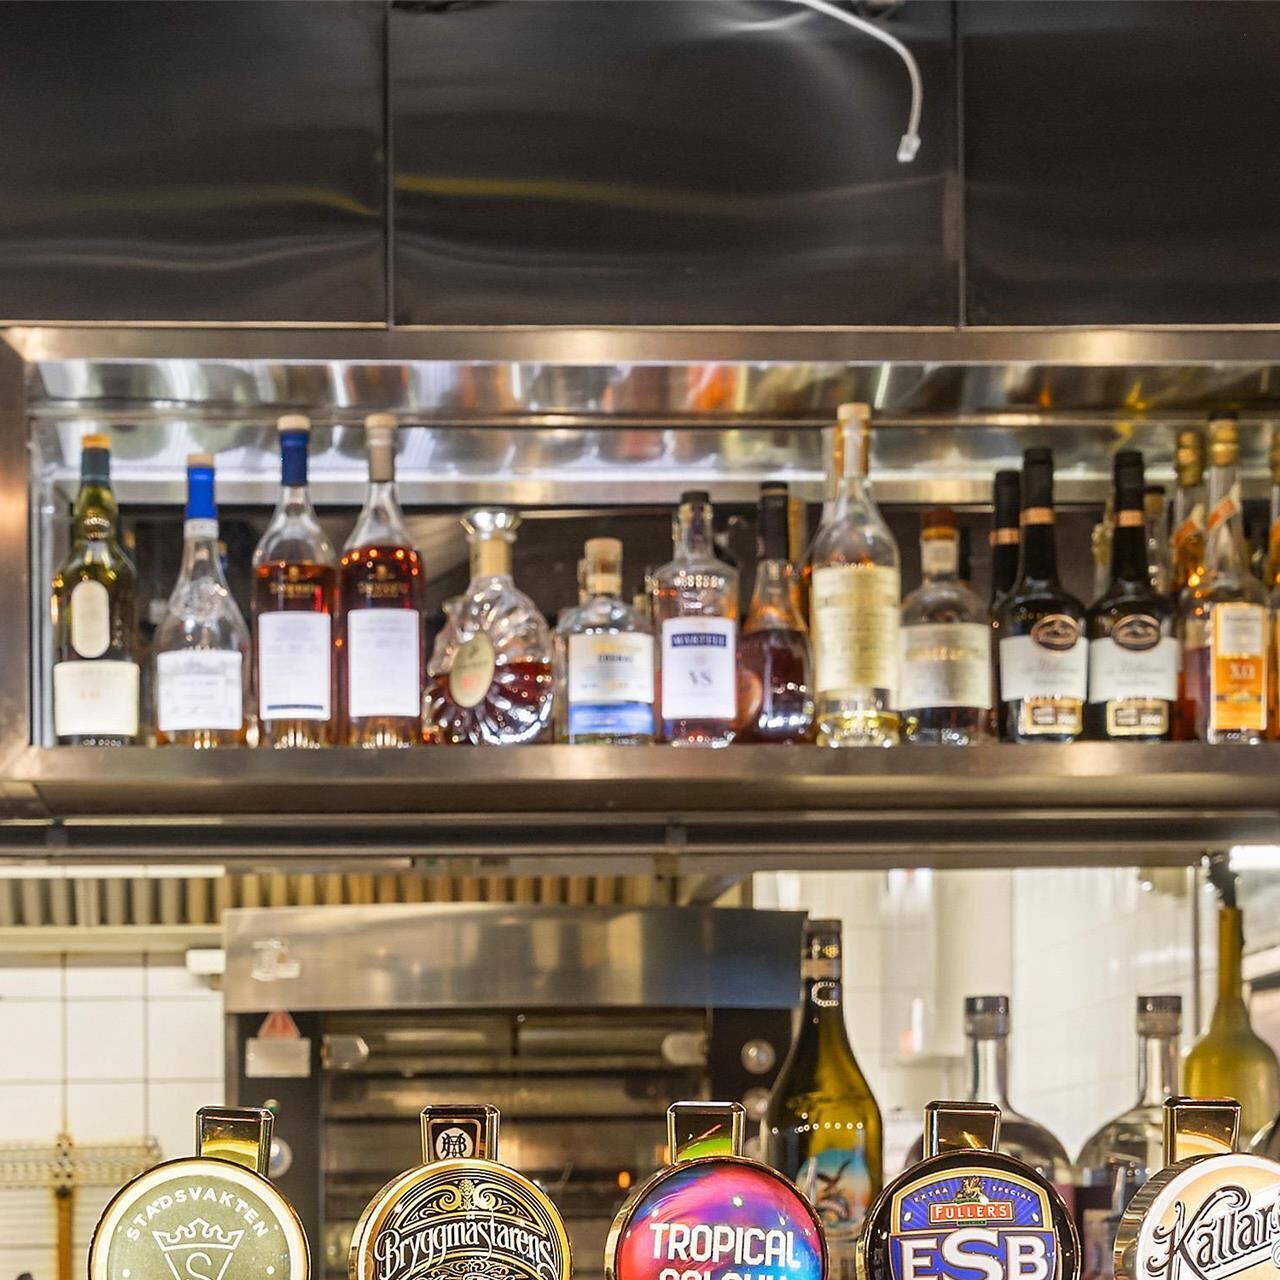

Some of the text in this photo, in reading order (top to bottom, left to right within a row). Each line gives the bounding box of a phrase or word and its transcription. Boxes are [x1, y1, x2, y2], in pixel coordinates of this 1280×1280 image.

[126, 1186, 270, 1241] STADSVAKTEN
[913, 1185, 1032, 1203] EXTRA SPECIAL
[649, 1222, 802, 1269] TROPICAL
